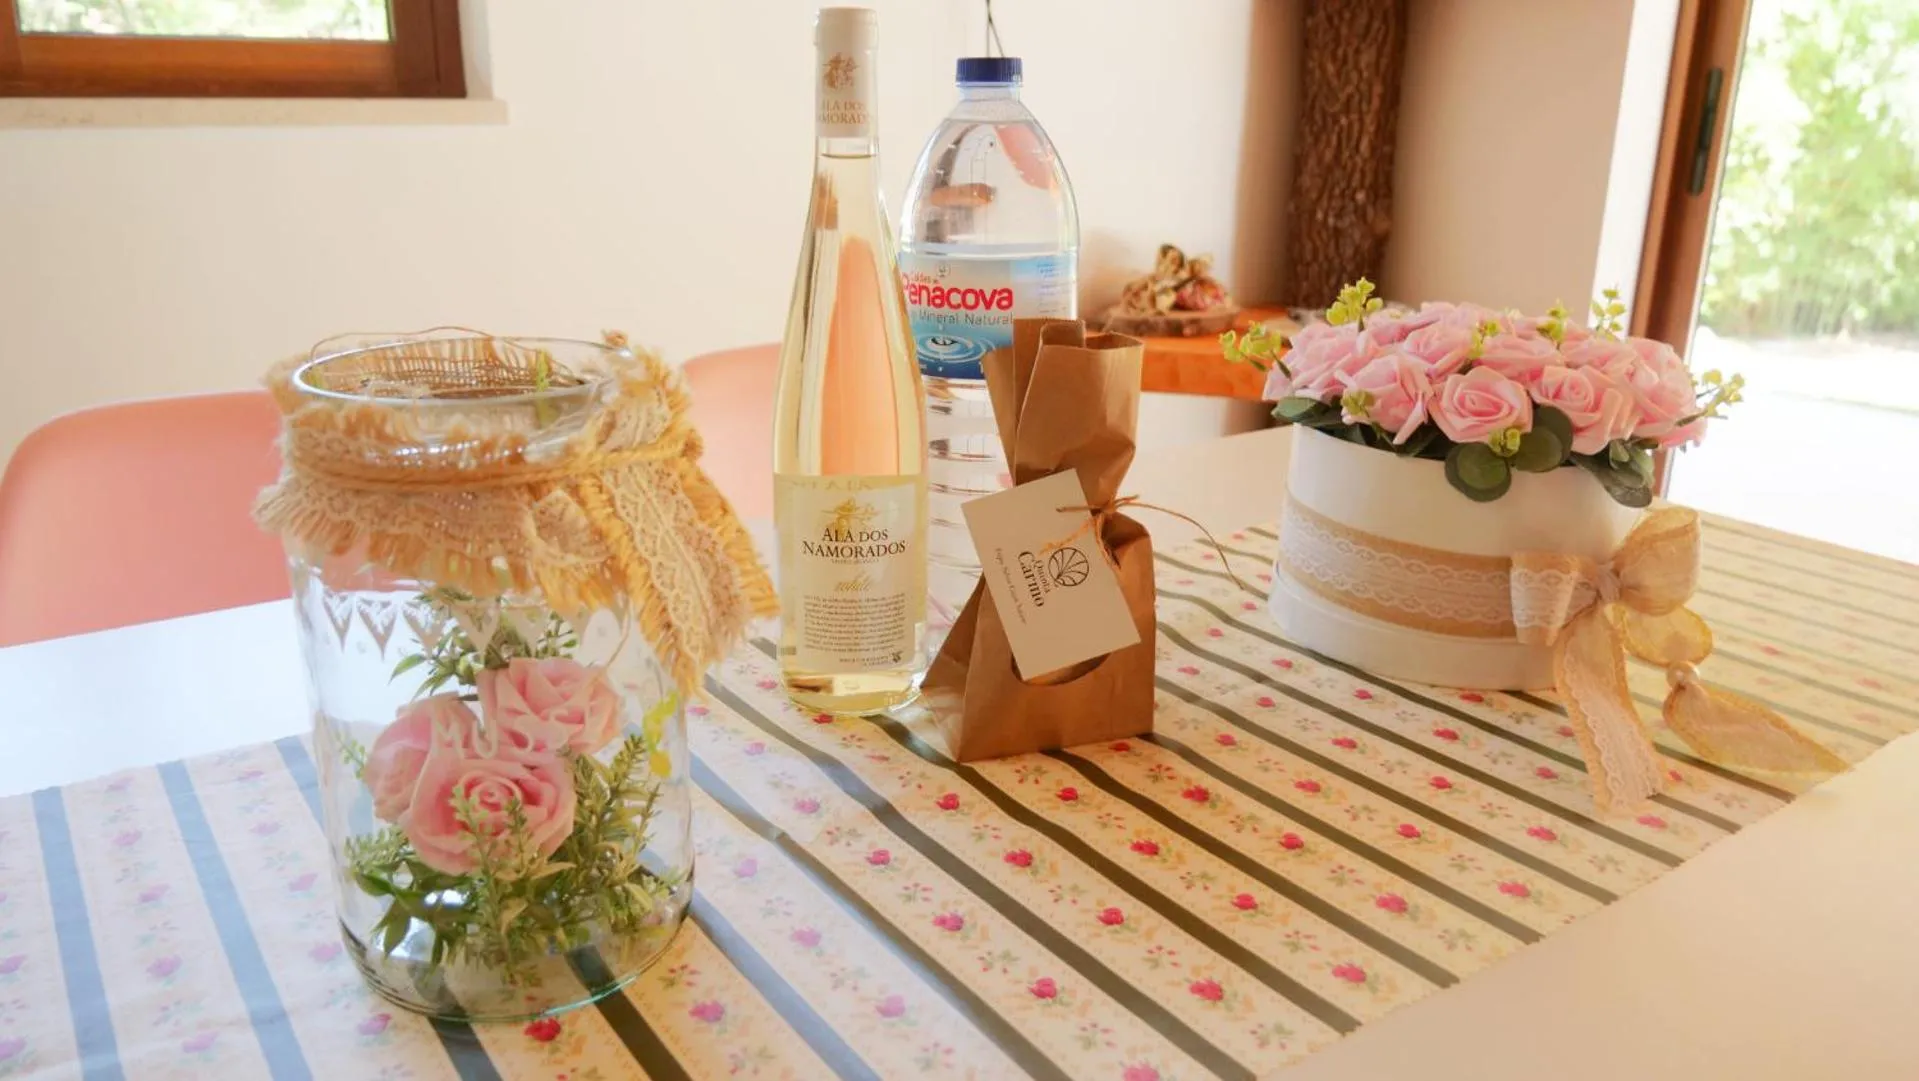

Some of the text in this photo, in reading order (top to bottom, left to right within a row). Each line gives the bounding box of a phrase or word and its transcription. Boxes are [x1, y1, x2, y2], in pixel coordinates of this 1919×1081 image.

[964, 313, 1014, 327] Natural
[822, 527, 889, 543] ALA DOS
[802, 540, 906, 559] NAMORADOS
[1018, 550, 1045, 607] Carmo
[1034, 559, 1050, 593] Quinta
